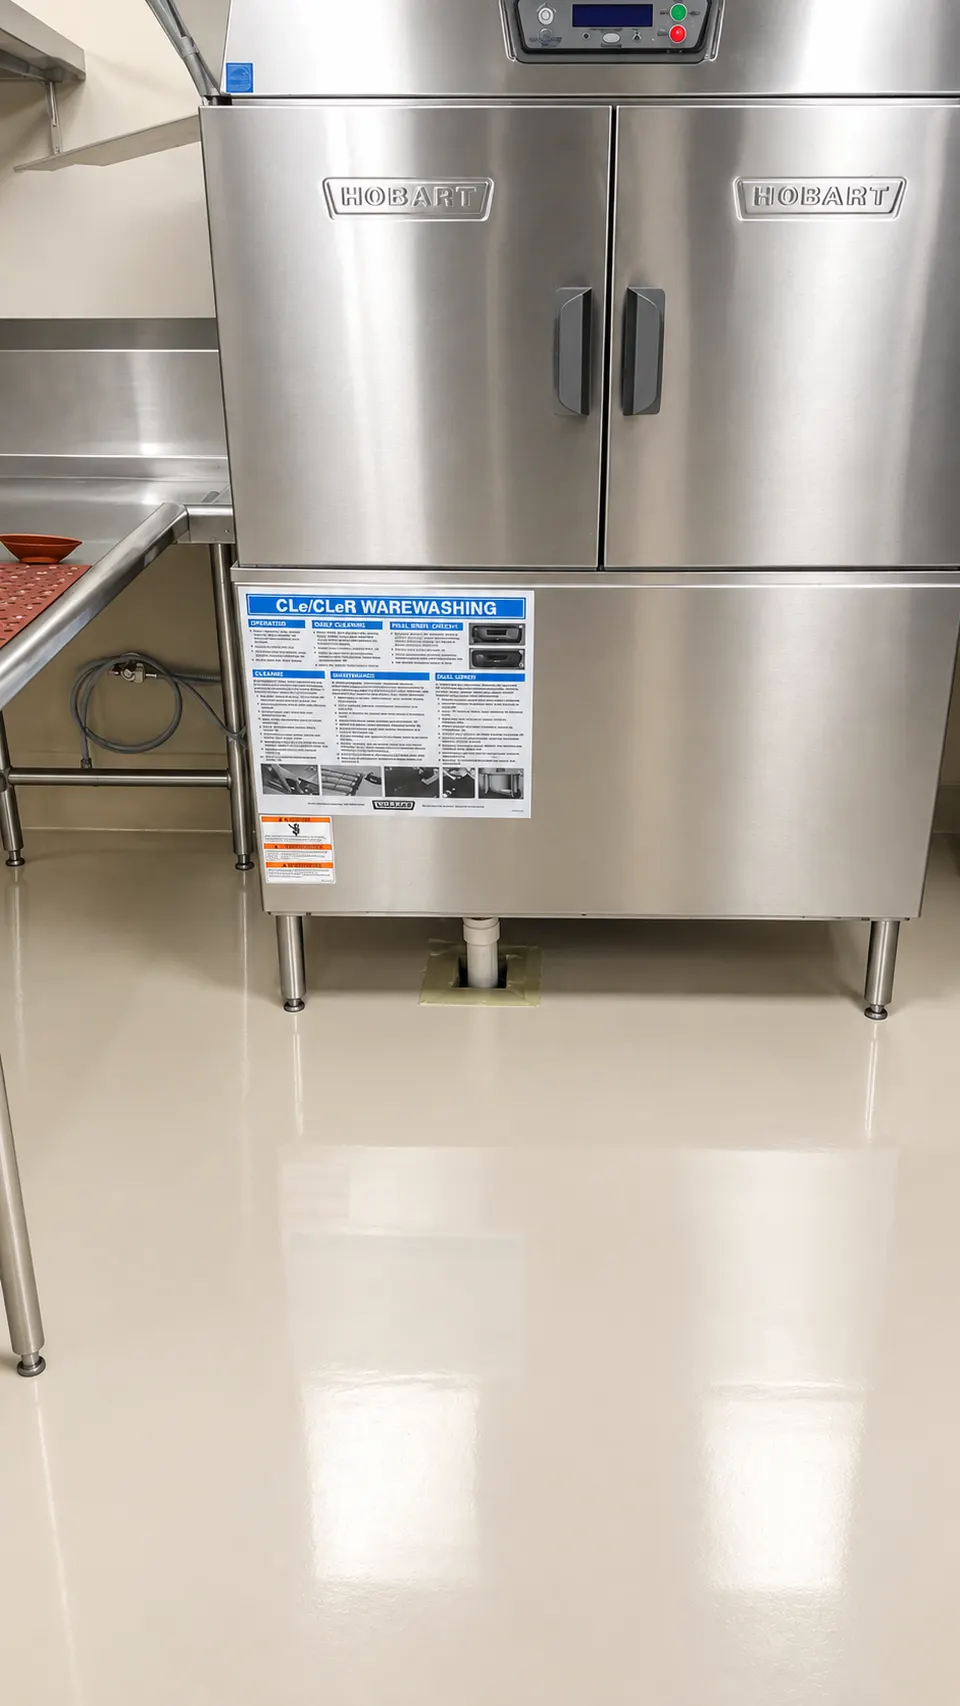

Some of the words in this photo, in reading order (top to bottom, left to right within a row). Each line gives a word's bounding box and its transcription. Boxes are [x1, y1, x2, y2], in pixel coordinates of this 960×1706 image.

[341, 186, 477, 207] HOBART
[753, 186, 890, 206] HOBART
[275, 598, 356, 615] CLe/CLeR
[361, 600, 497, 616] WAREWASHING
